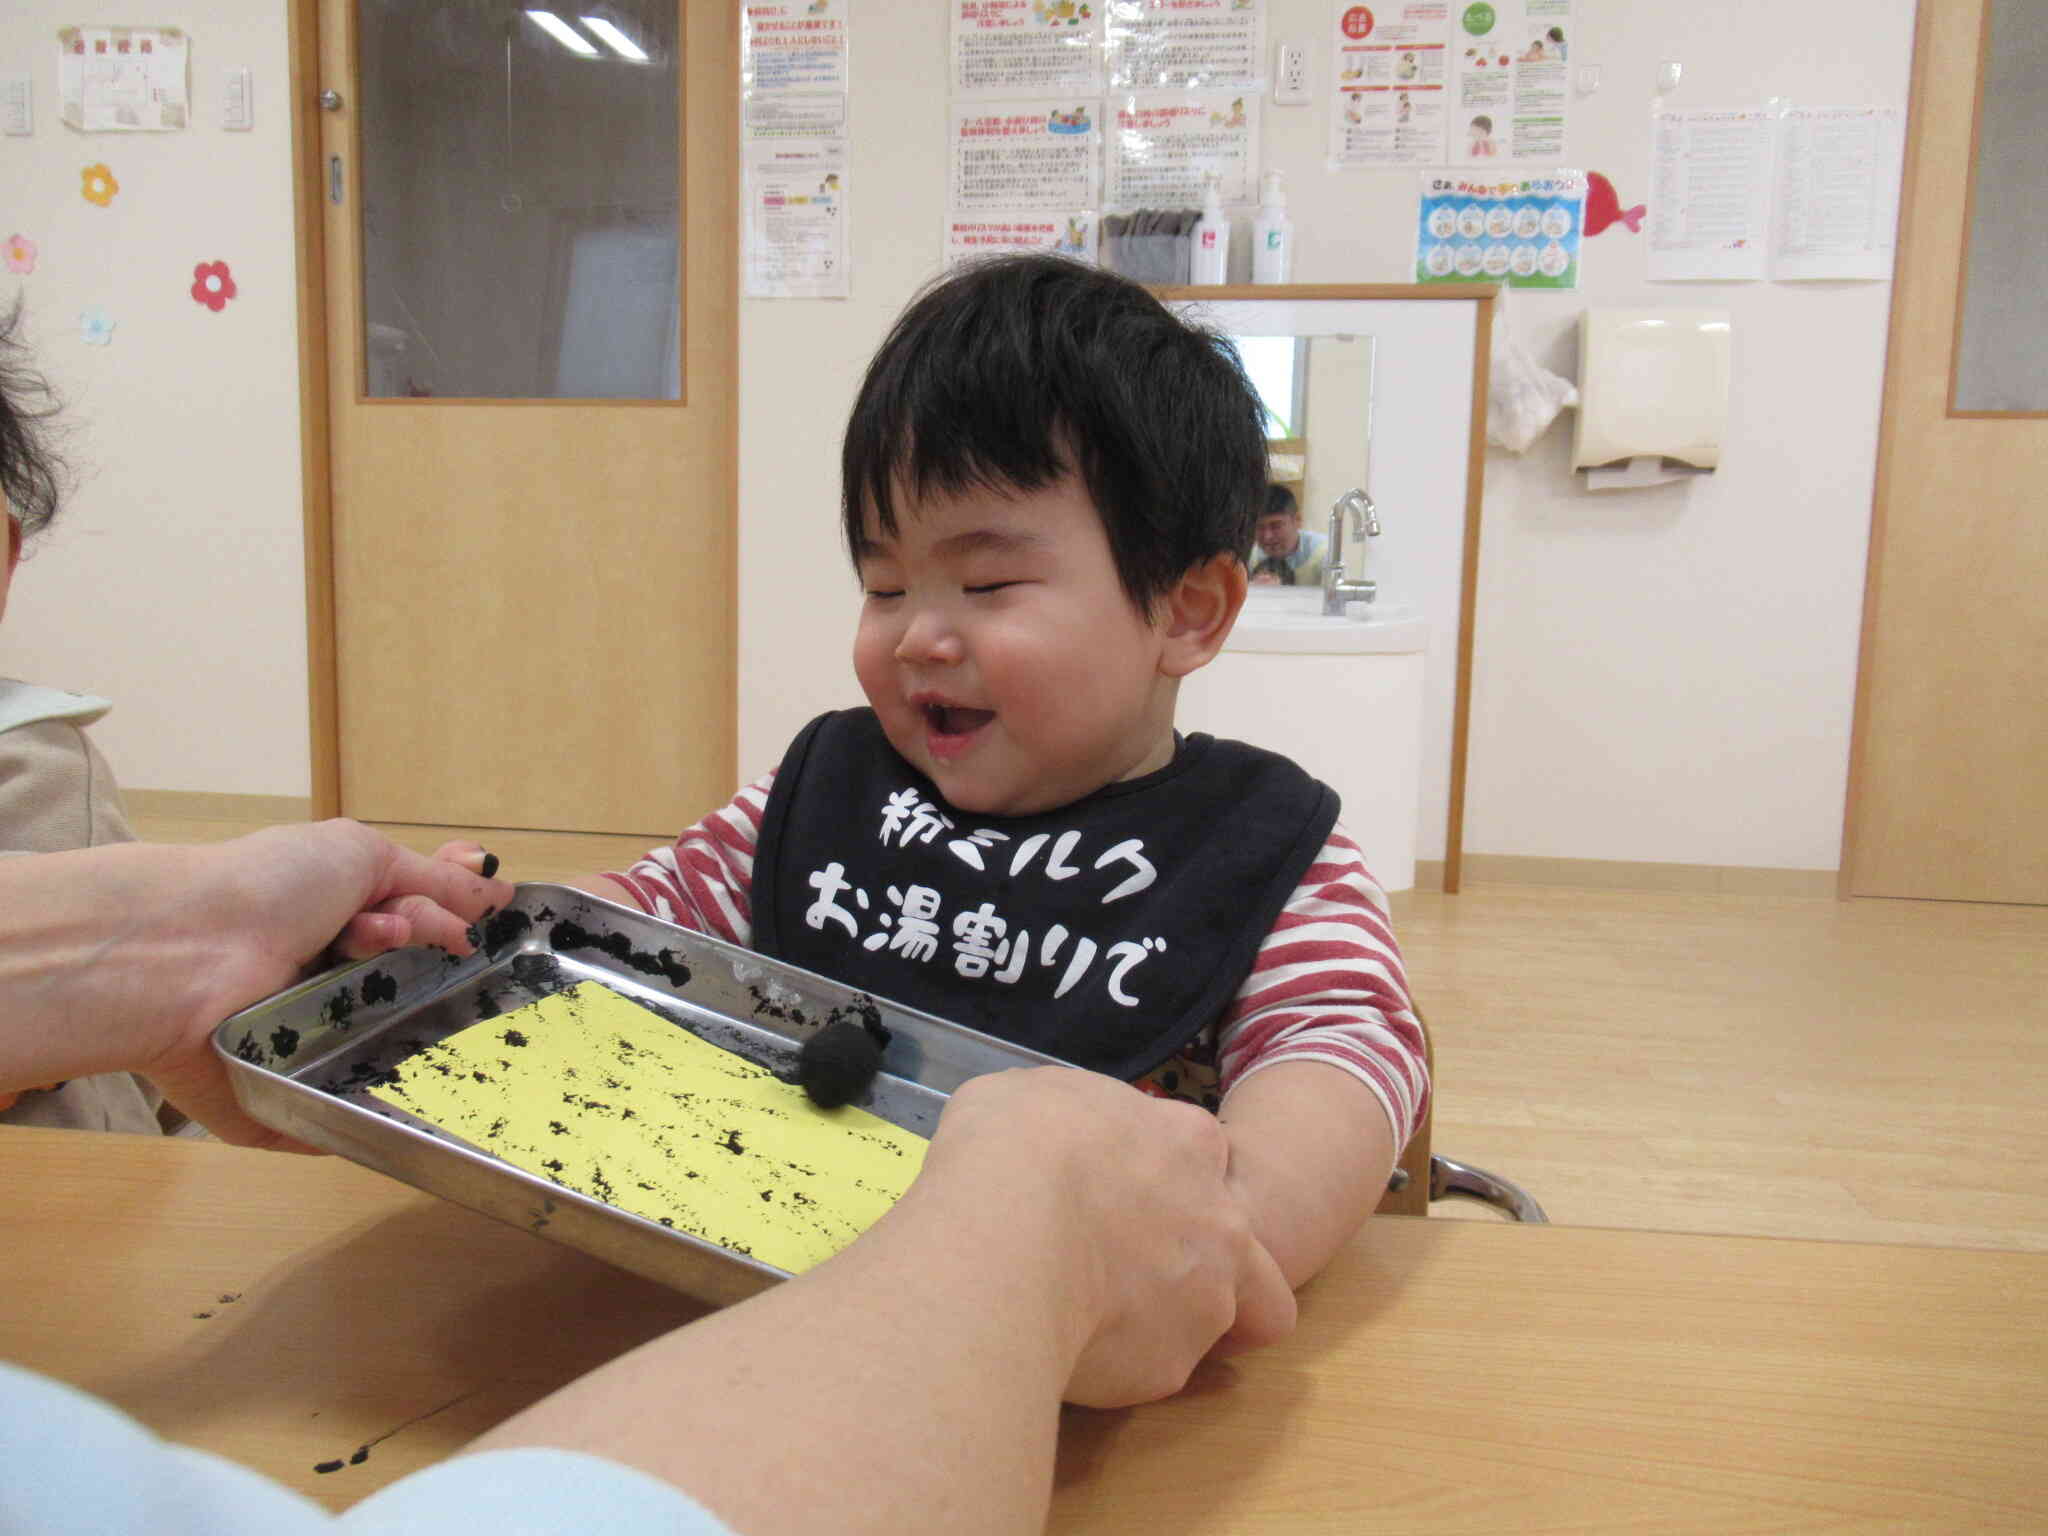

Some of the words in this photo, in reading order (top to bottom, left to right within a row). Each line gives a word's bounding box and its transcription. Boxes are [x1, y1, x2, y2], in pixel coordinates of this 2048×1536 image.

[879, 786, 1159, 904] 粉ミルク
[805, 861, 1167, 1008] お湯割りで
